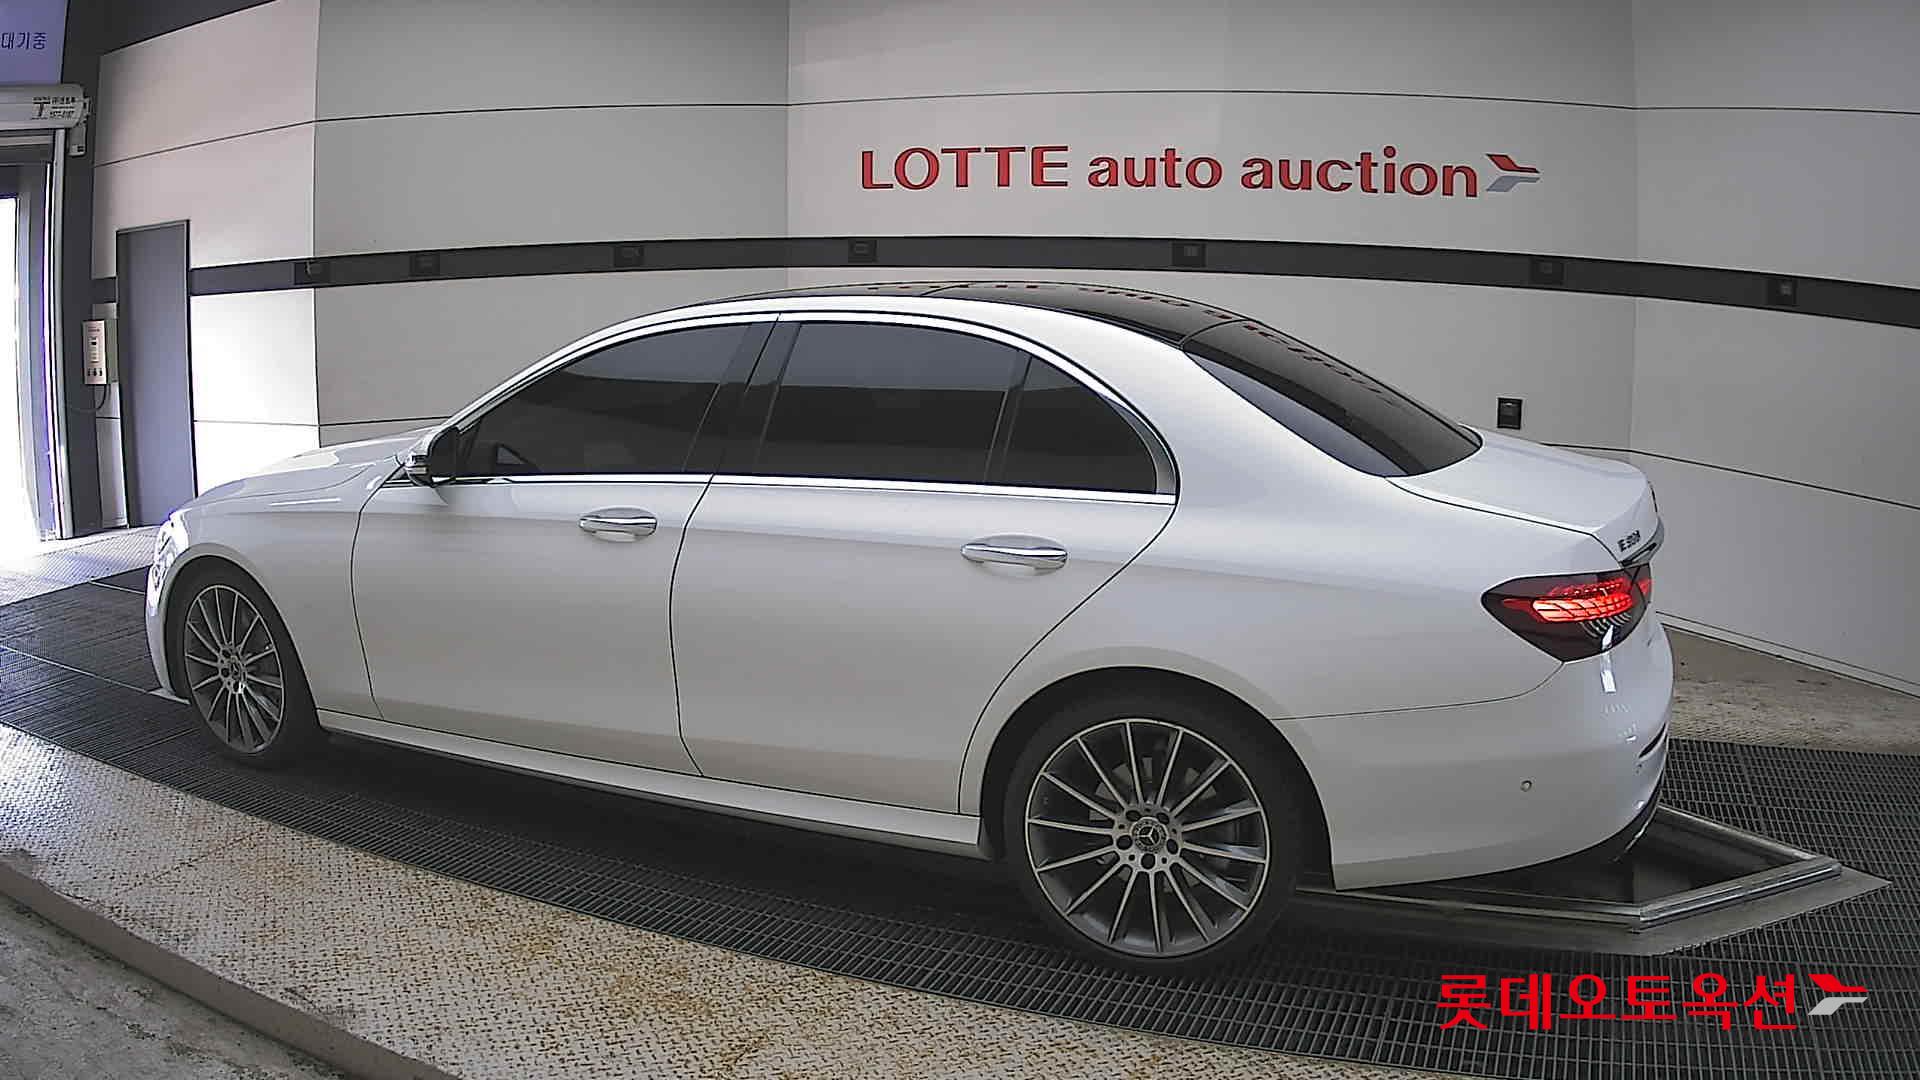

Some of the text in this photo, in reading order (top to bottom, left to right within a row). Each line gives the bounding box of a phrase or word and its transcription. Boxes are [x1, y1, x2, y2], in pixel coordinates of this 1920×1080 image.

[862, 146, 1477, 198] LOTTE auto auction
